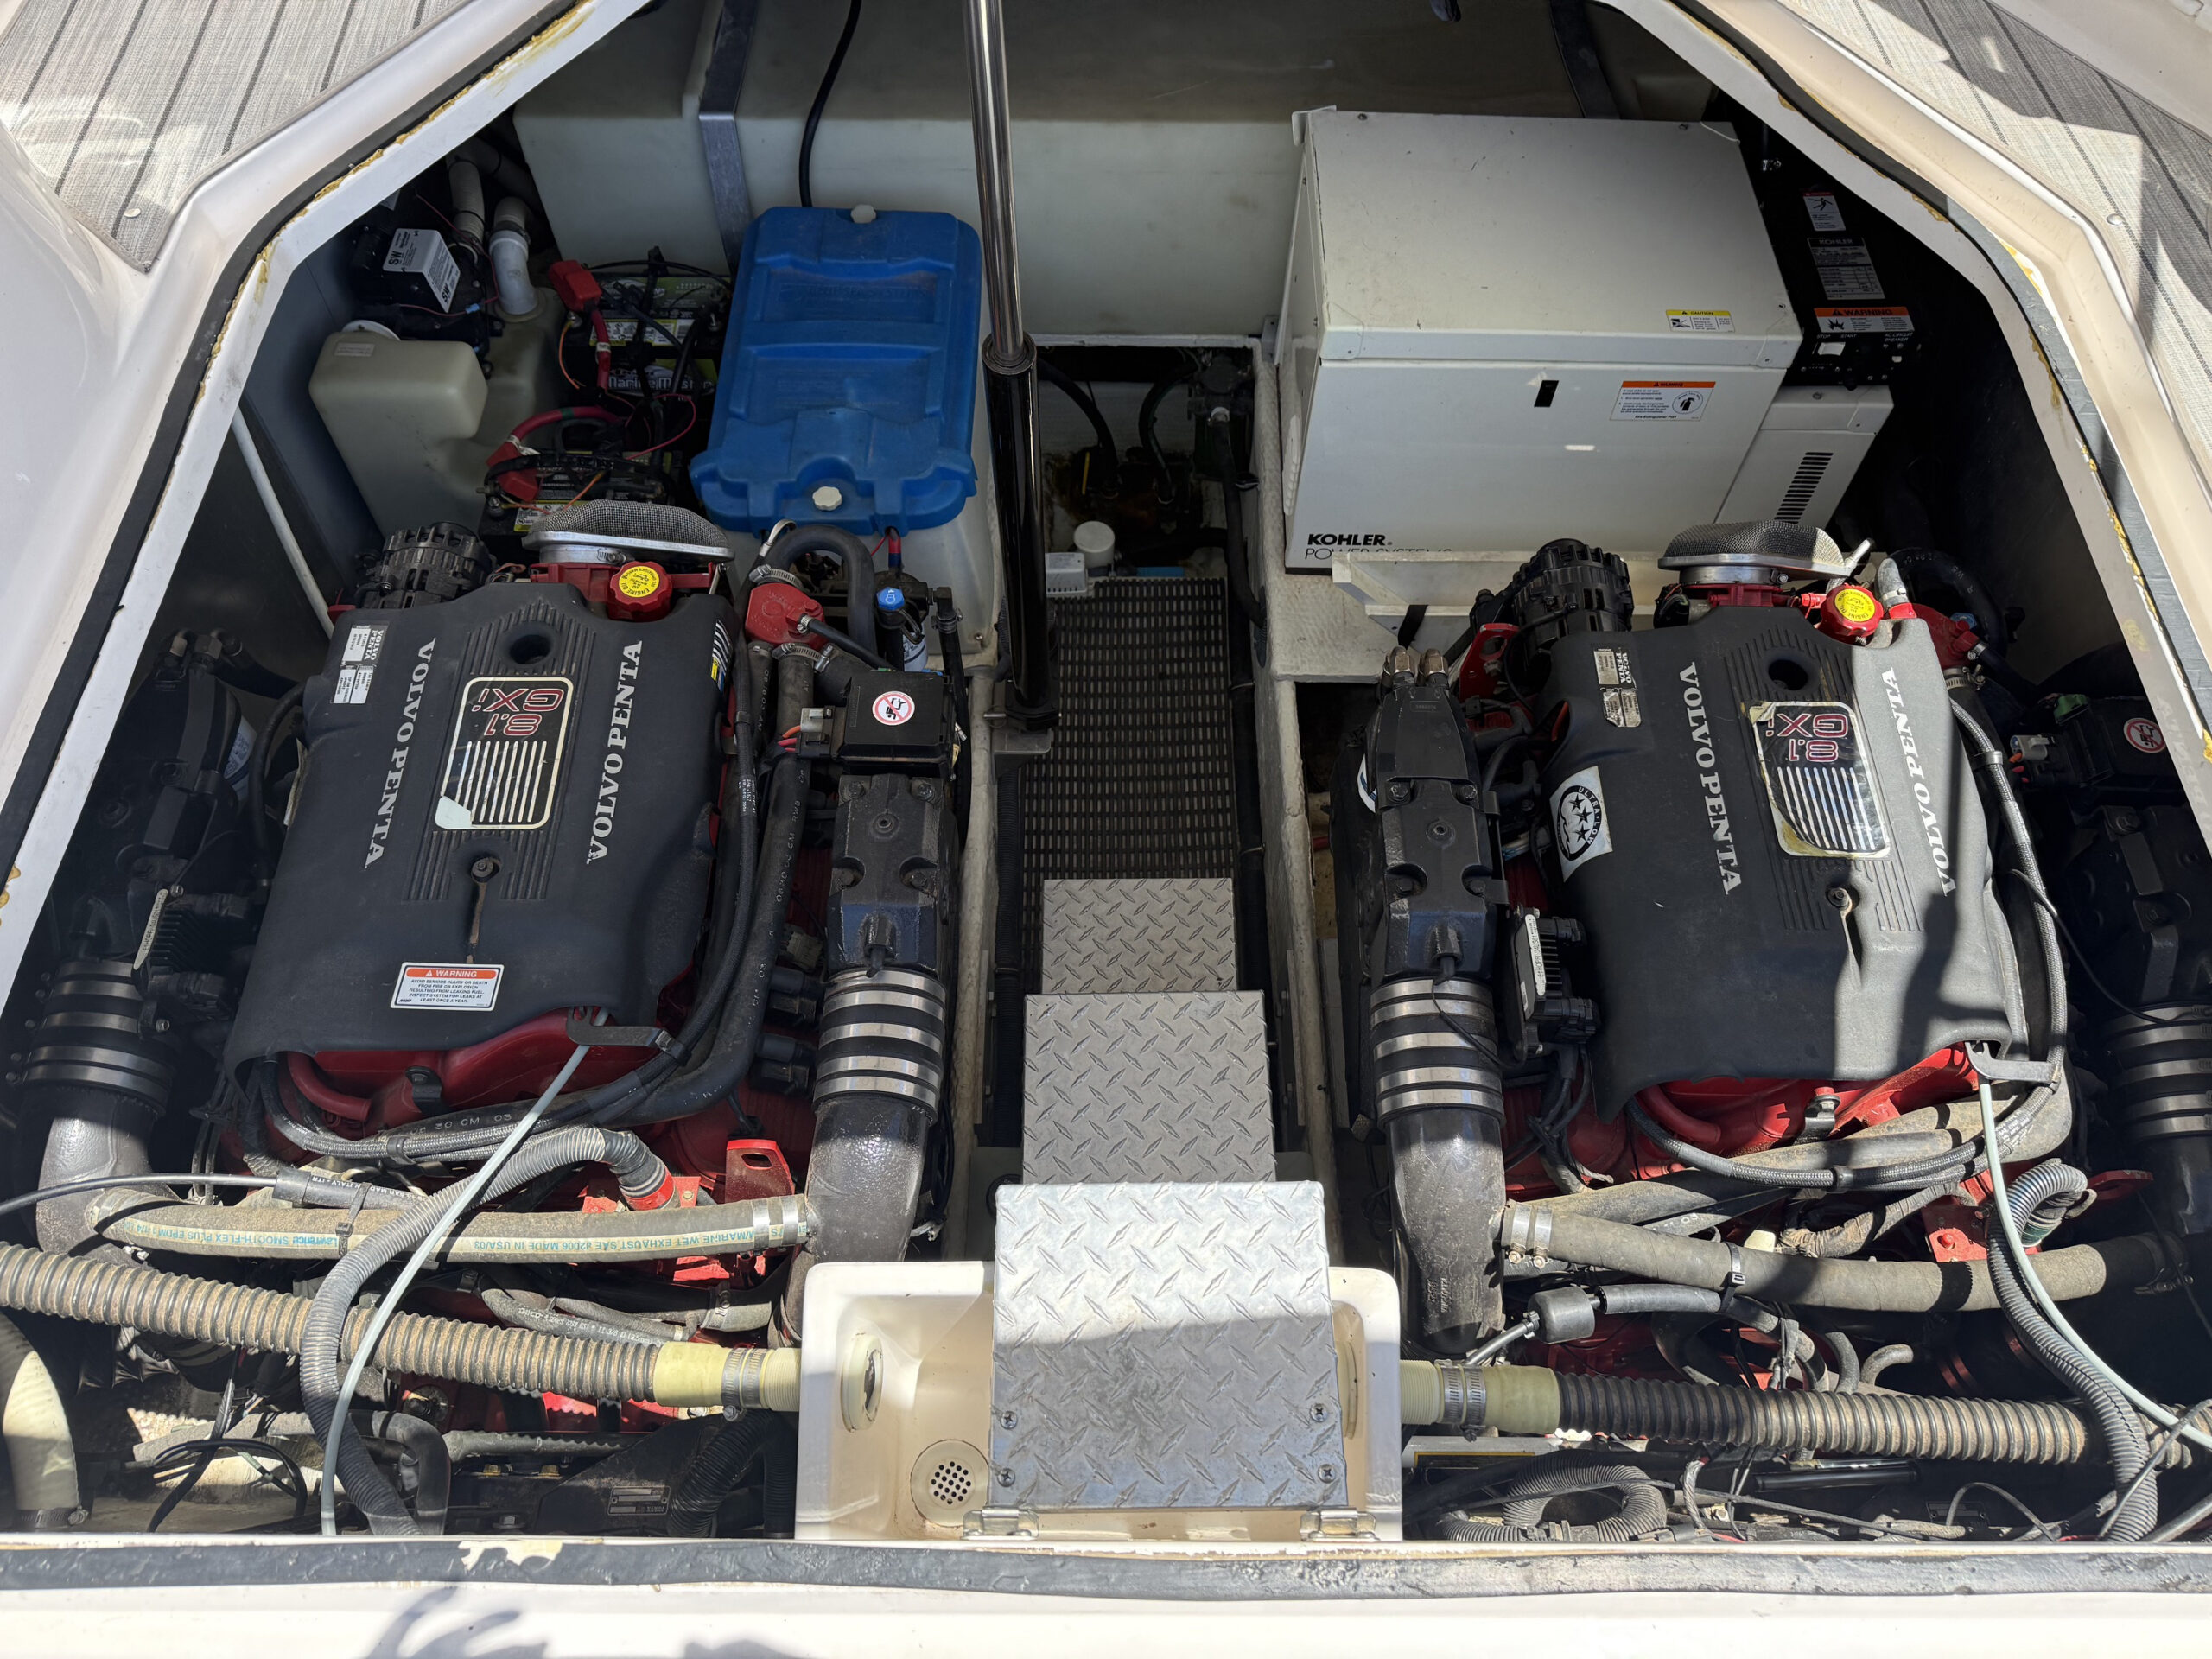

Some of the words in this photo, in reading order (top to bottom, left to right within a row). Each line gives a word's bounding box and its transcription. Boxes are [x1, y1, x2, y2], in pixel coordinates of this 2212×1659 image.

[365, 630, 378, 660] PENTA
[371, 629, 384, 661] VOLVO
[1616, 652, 1625, 683] PENTA
[1623, 652, 1632, 683] VOLVO
[397, 637, 436, 744] VOLVO
[471, 688, 563, 712] GXi
[484, 713, 542, 736] 8.1
[1765, 714, 1847, 738] GXi
[1881, 666, 1925, 779] PENTA
[588, 753, 623, 865] VOLVO
[607, 639, 644, 750] PENTA
[1789, 739, 1838, 762] 8.1
[1679, 661, 1715, 768] VOLVO
[1700, 772, 1742, 895] PENTA
[365, 746, 410, 868] PENTA
[1578, 786, 1601, 814] ULTRA
[1586, 822, 1601, 845] LOW
[1913, 782, 1957, 897] VOLVO
[331, 1179, 353, 1188] ITALY
[158, 1228, 184, 1239] EPDM
[187, 1230, 212, 1242] PLUS
[215, 1233, 289, 1246] SMOOTH-FLEX
[620, 1237, 672, 1251] EXHAUST
[676, 1236, 699, 1247] WET
[474, 1241, 511, 1250] USA/03
[514, 1242, 524, 1250] IN
[529, 1242, 558, 1250] MADE
[595, 1242, 617, 1250] SAE
